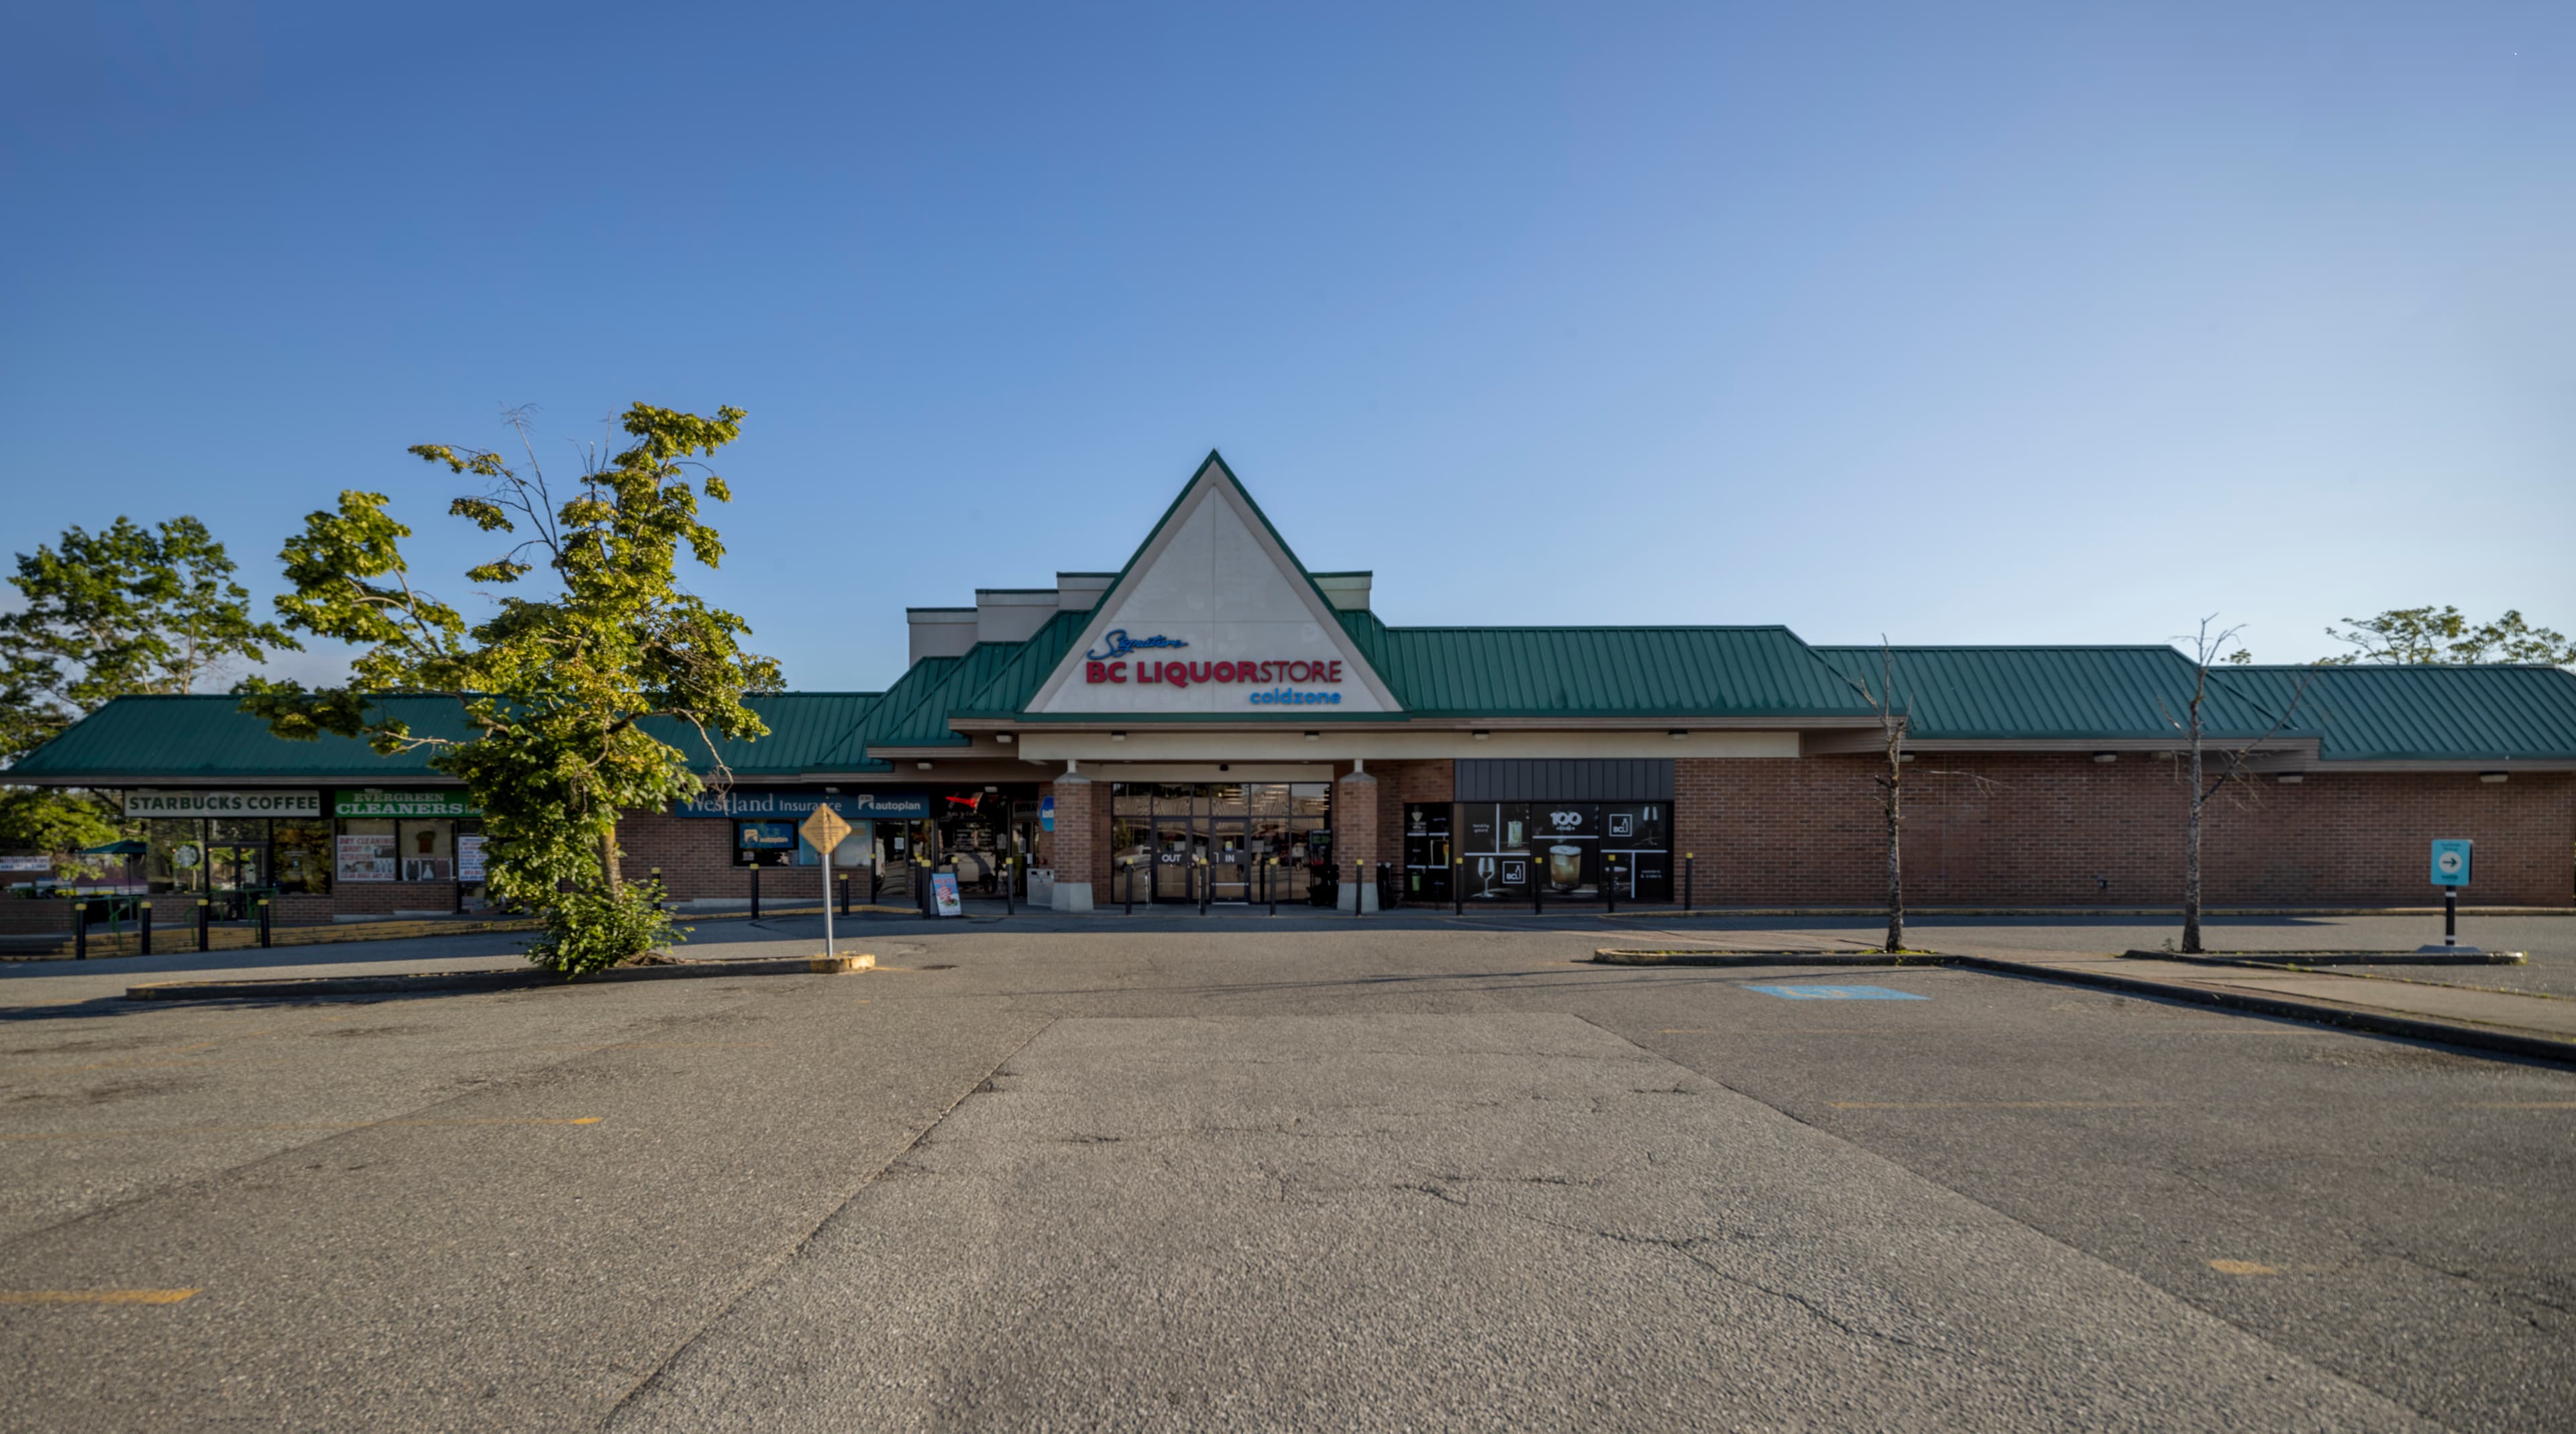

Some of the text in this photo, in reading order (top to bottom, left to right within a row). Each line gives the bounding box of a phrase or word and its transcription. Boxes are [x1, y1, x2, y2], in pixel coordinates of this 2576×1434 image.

[1086, 629, 1189, 660] Signature
[1086, 661, 1127, 683] BC
[1250, 687, 1342, 704] coldzone
[129, 796, 318, 810] STARBUCKS COFFEE
[354, 793, 445, 802] EVERGREEN
[335, 804, 463, 814] CLEANERS
[780, 799, 843, 812] Insurace
[875, 801, 921, 812] autoplan
[1550, 812, 1582, 826] 100
[1161, 854, 1181, 863] OUT
[1225, 854, 1235, 863] IN
